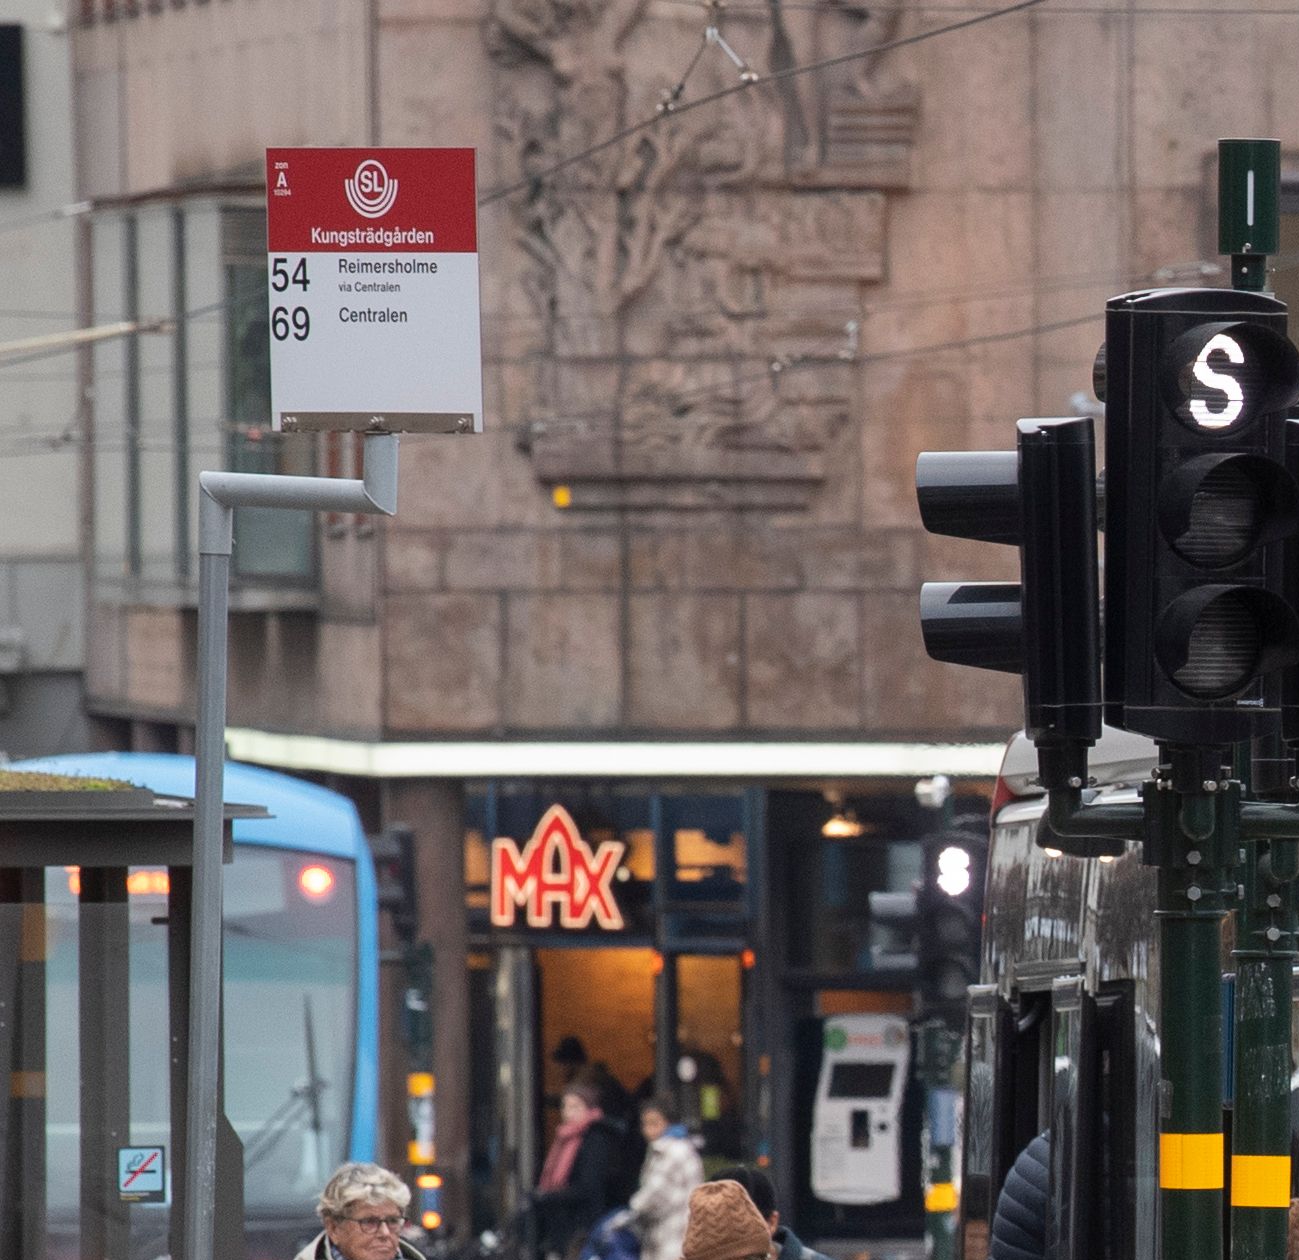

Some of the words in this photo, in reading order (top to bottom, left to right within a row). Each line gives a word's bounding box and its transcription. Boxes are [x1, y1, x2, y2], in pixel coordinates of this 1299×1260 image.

[276, 171, 288, 187] A
[360, 171, 383, 192] SL
[311, 226, 434, 246] Kungsträdgården
[271, 257, 310, 293] 54
[338, 258, 438, 274] Reimersholme
[338, 281, 352, 293] via
[354, 281, 401, 293] Centralen
[271, 306, 311, 342] 69
[338, 306, 408, 323] Centralen
[1190, 334, 1244, 428] S
[491, 804, 624, 930] MAX
